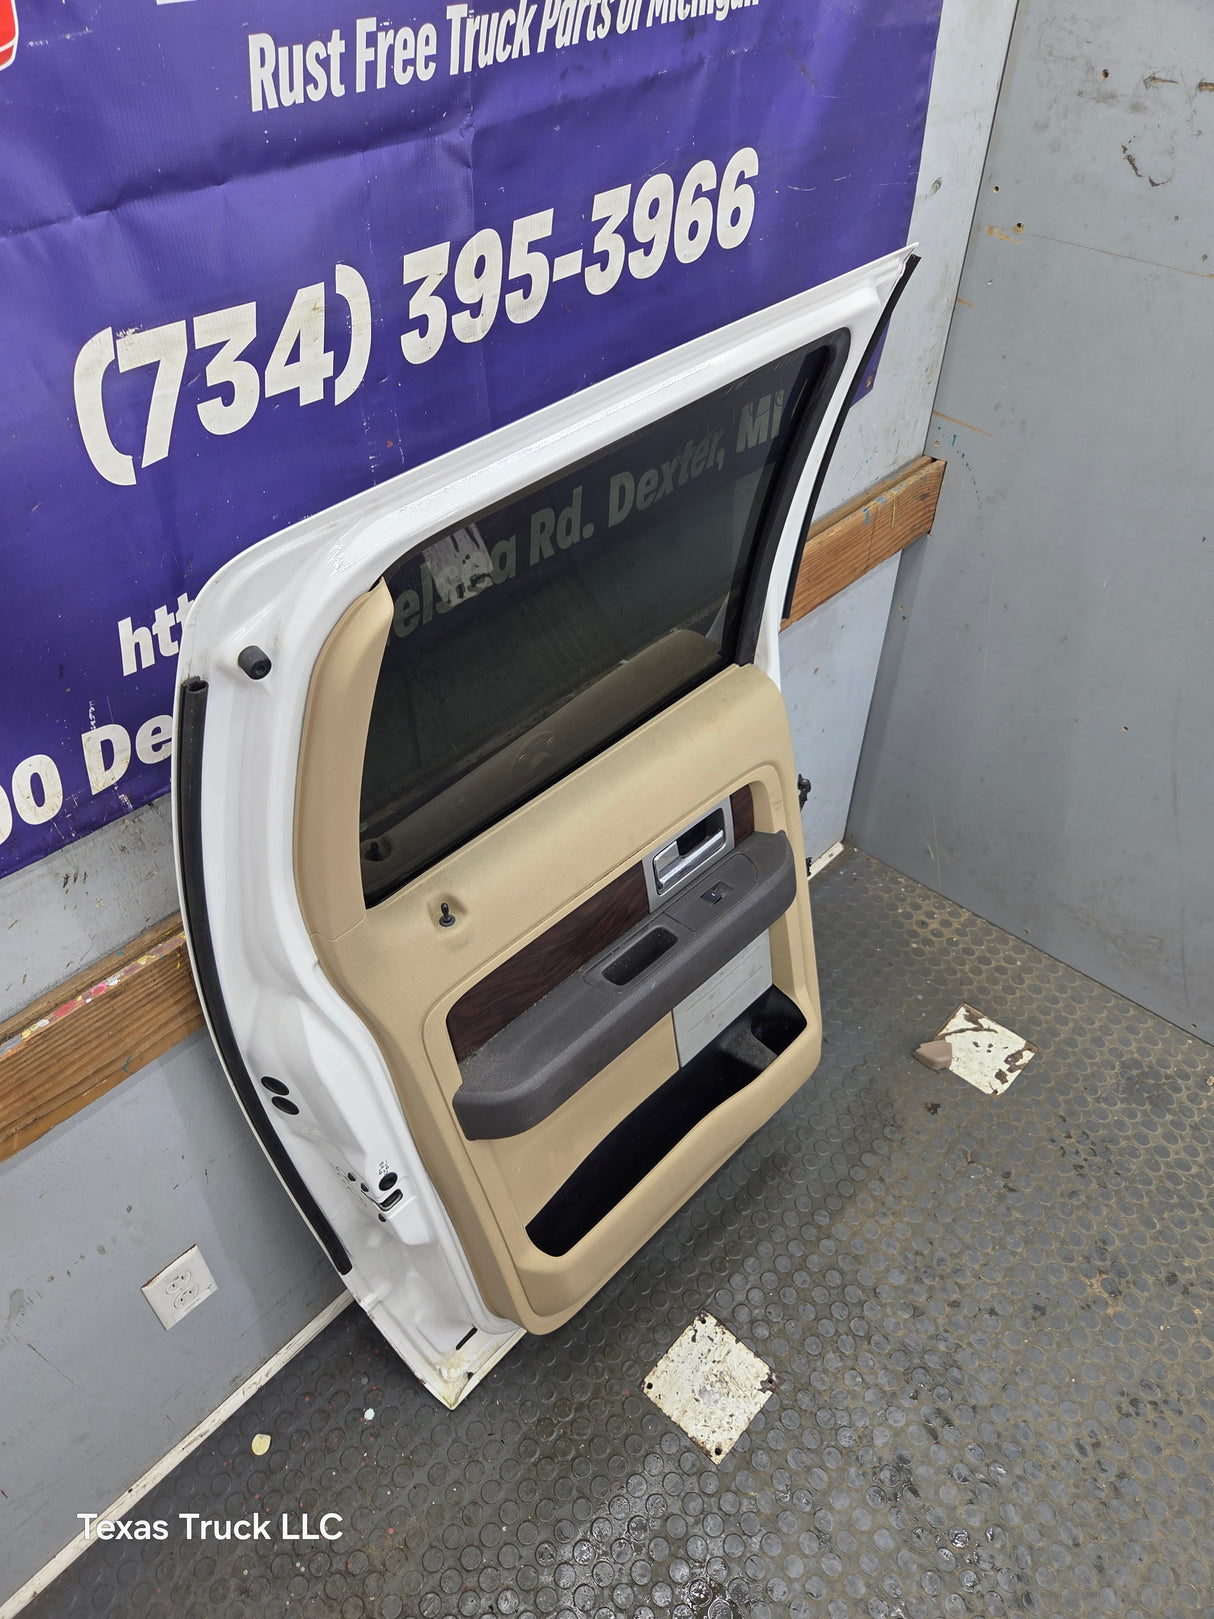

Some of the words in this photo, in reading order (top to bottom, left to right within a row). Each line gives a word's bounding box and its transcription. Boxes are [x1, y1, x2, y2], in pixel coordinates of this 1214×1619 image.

[248, 29, 346, 112] Rust
[355, 17, 437, 93] Free
[446, 0, 537, 76] Truck
[536, 0, 612, 53] Parts
[73, 264, 372, 485] (734)
[399, 147, 759, 365] 395-3966
[529, 485, 595, 568] Rd.
[608, 430, 725, 528] Dexter,
[736, 388, 785, 453] MI
